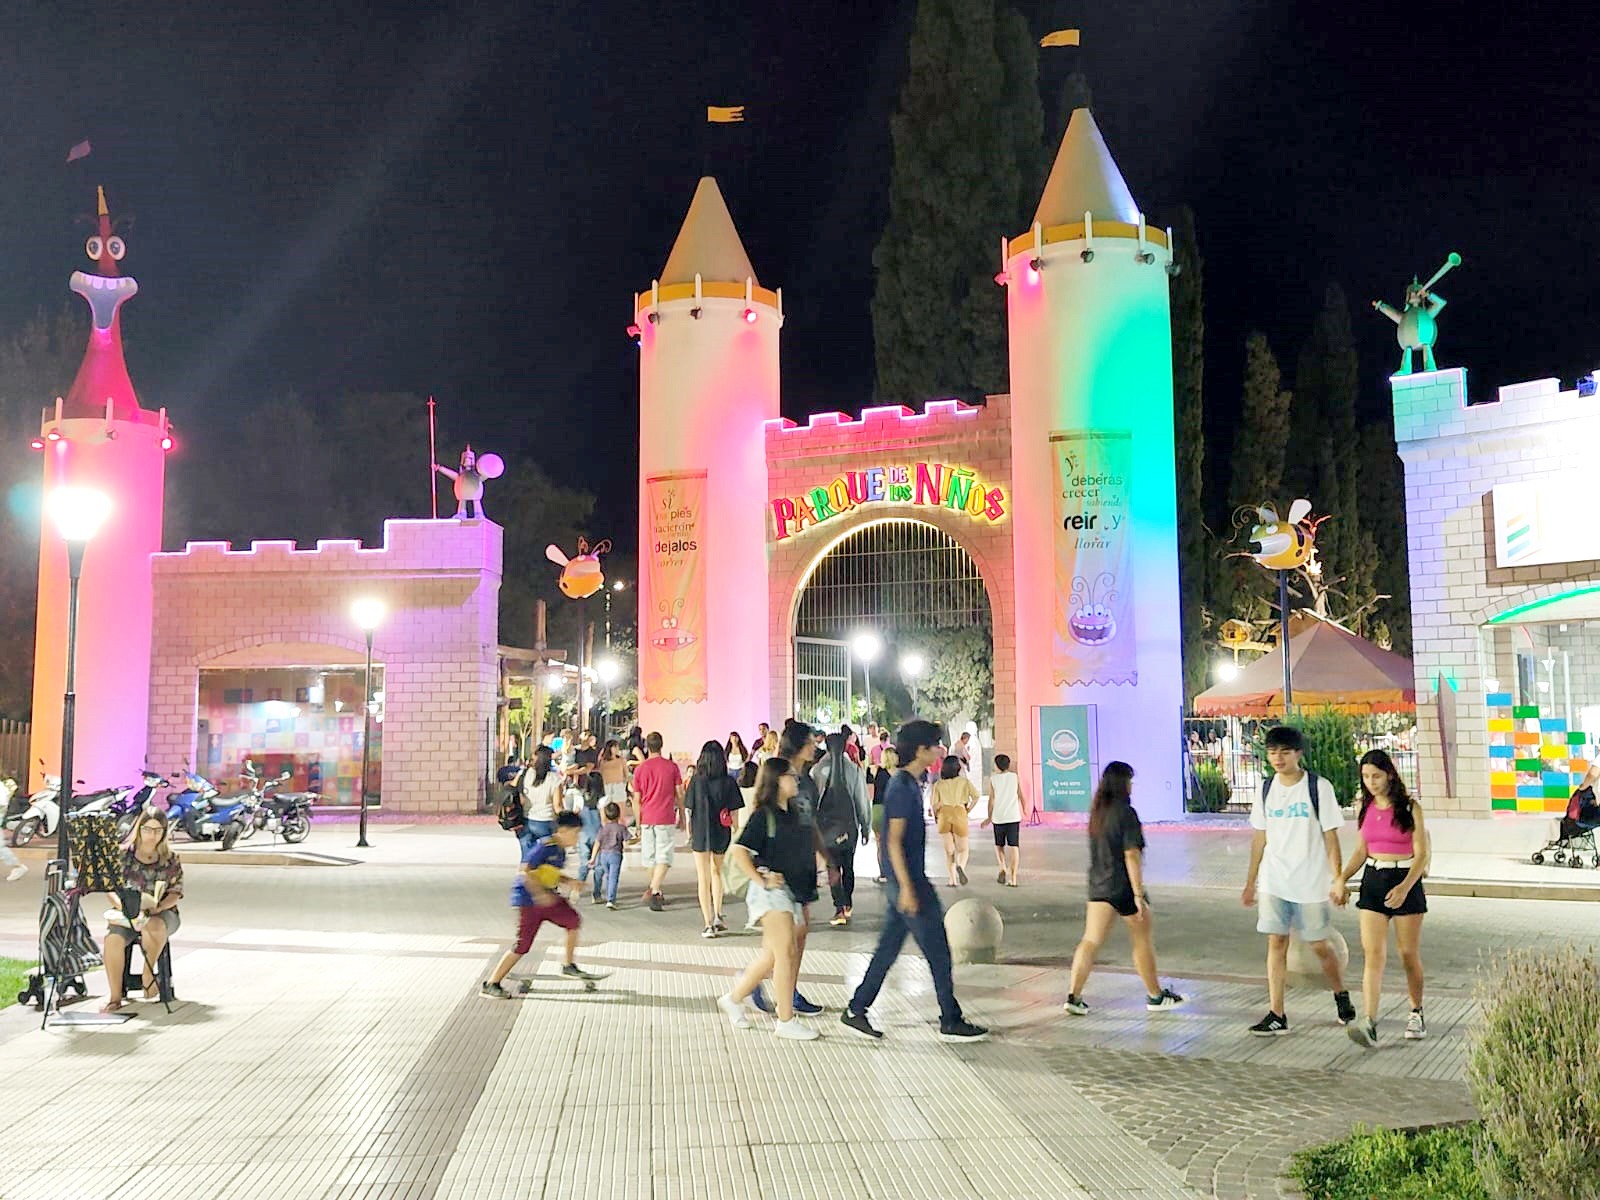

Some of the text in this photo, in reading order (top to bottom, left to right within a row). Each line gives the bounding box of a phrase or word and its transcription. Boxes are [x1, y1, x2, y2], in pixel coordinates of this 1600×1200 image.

[770, 462, 1005, 540] PARQUE DE LOS NIÑOS
[671, 508, 692, 520] pies
[1112, 514, 1122, 530] y
[655, 540, 697, 555] dejalos
